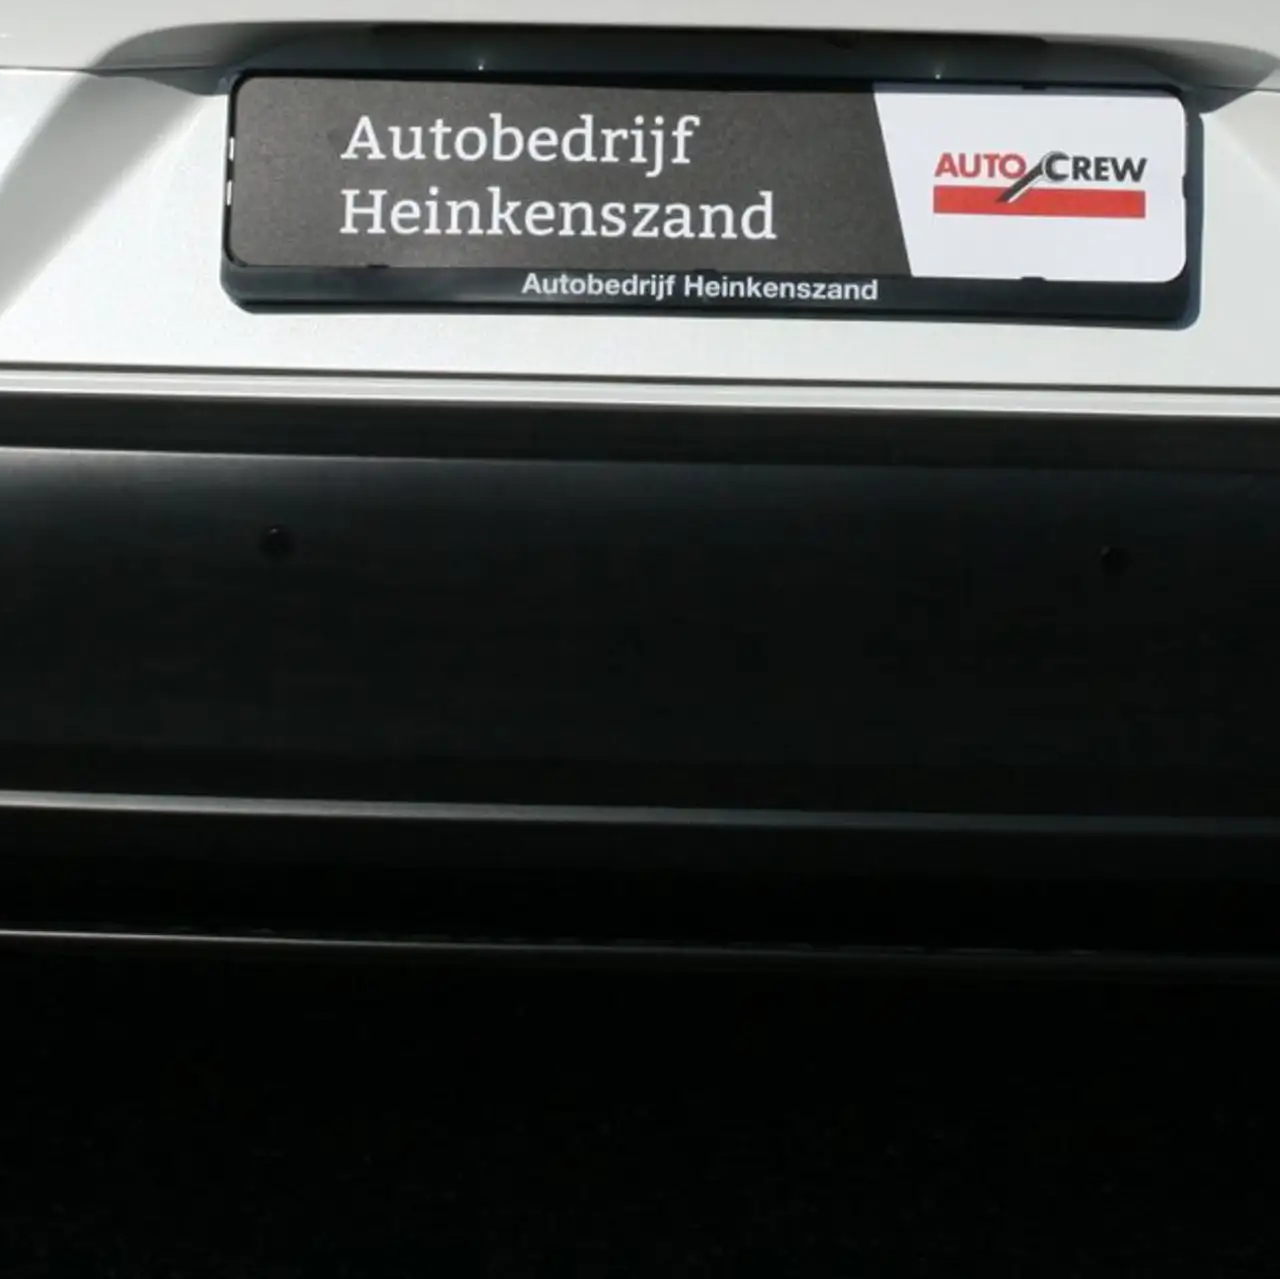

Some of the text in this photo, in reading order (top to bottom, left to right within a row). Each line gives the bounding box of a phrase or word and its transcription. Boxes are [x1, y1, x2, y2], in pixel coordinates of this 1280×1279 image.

[340, 113, 701, 178] Autobedrijf
[934, 151, 1148, 183] AUTO CREW
[340, 187, 778, 240] Heinkenszand
[521, 272, 879, 302] Autobedrijf Heinkenszand
